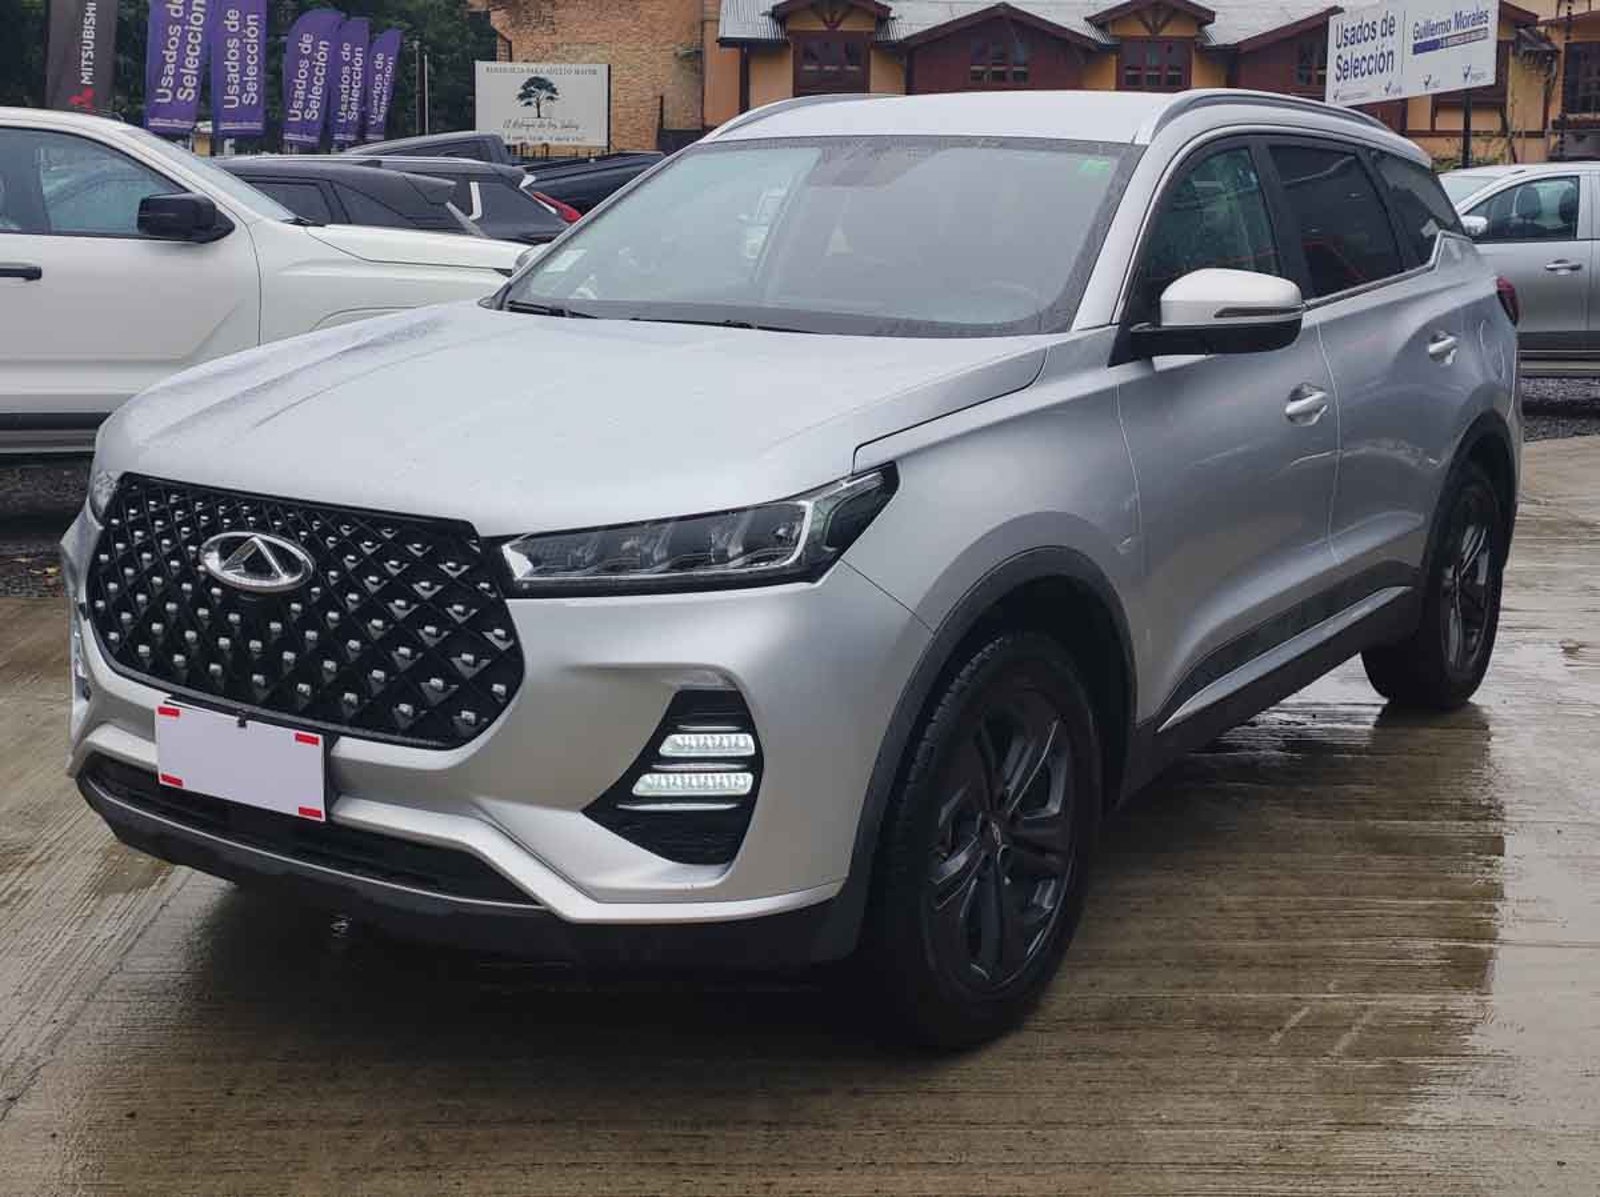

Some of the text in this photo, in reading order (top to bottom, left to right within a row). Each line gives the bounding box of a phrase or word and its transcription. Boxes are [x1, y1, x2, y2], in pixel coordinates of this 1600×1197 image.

[80, 2, 97, 85] MITSUBISHI
[176, 0, 206, 102] Selección
[223, 8, 240, 109] Usados de
[242, 14, 259, 105] Selección
[298, 32, 314, 55] de
[1335, 18, 1378, 49] Usados
[1380, 10, 1396, 38] de
[1412, 19, 1452, 41] Guillermo
[1454, 7, 1489, 32] Morales
[154, 25, 182, 104] Usados
[288, 59, 310, 122] Usados
[304, 39, 330, 121] Selección
[337, 65, 351, 123] Usados
[1335, 44, 1395, 82] Selección
